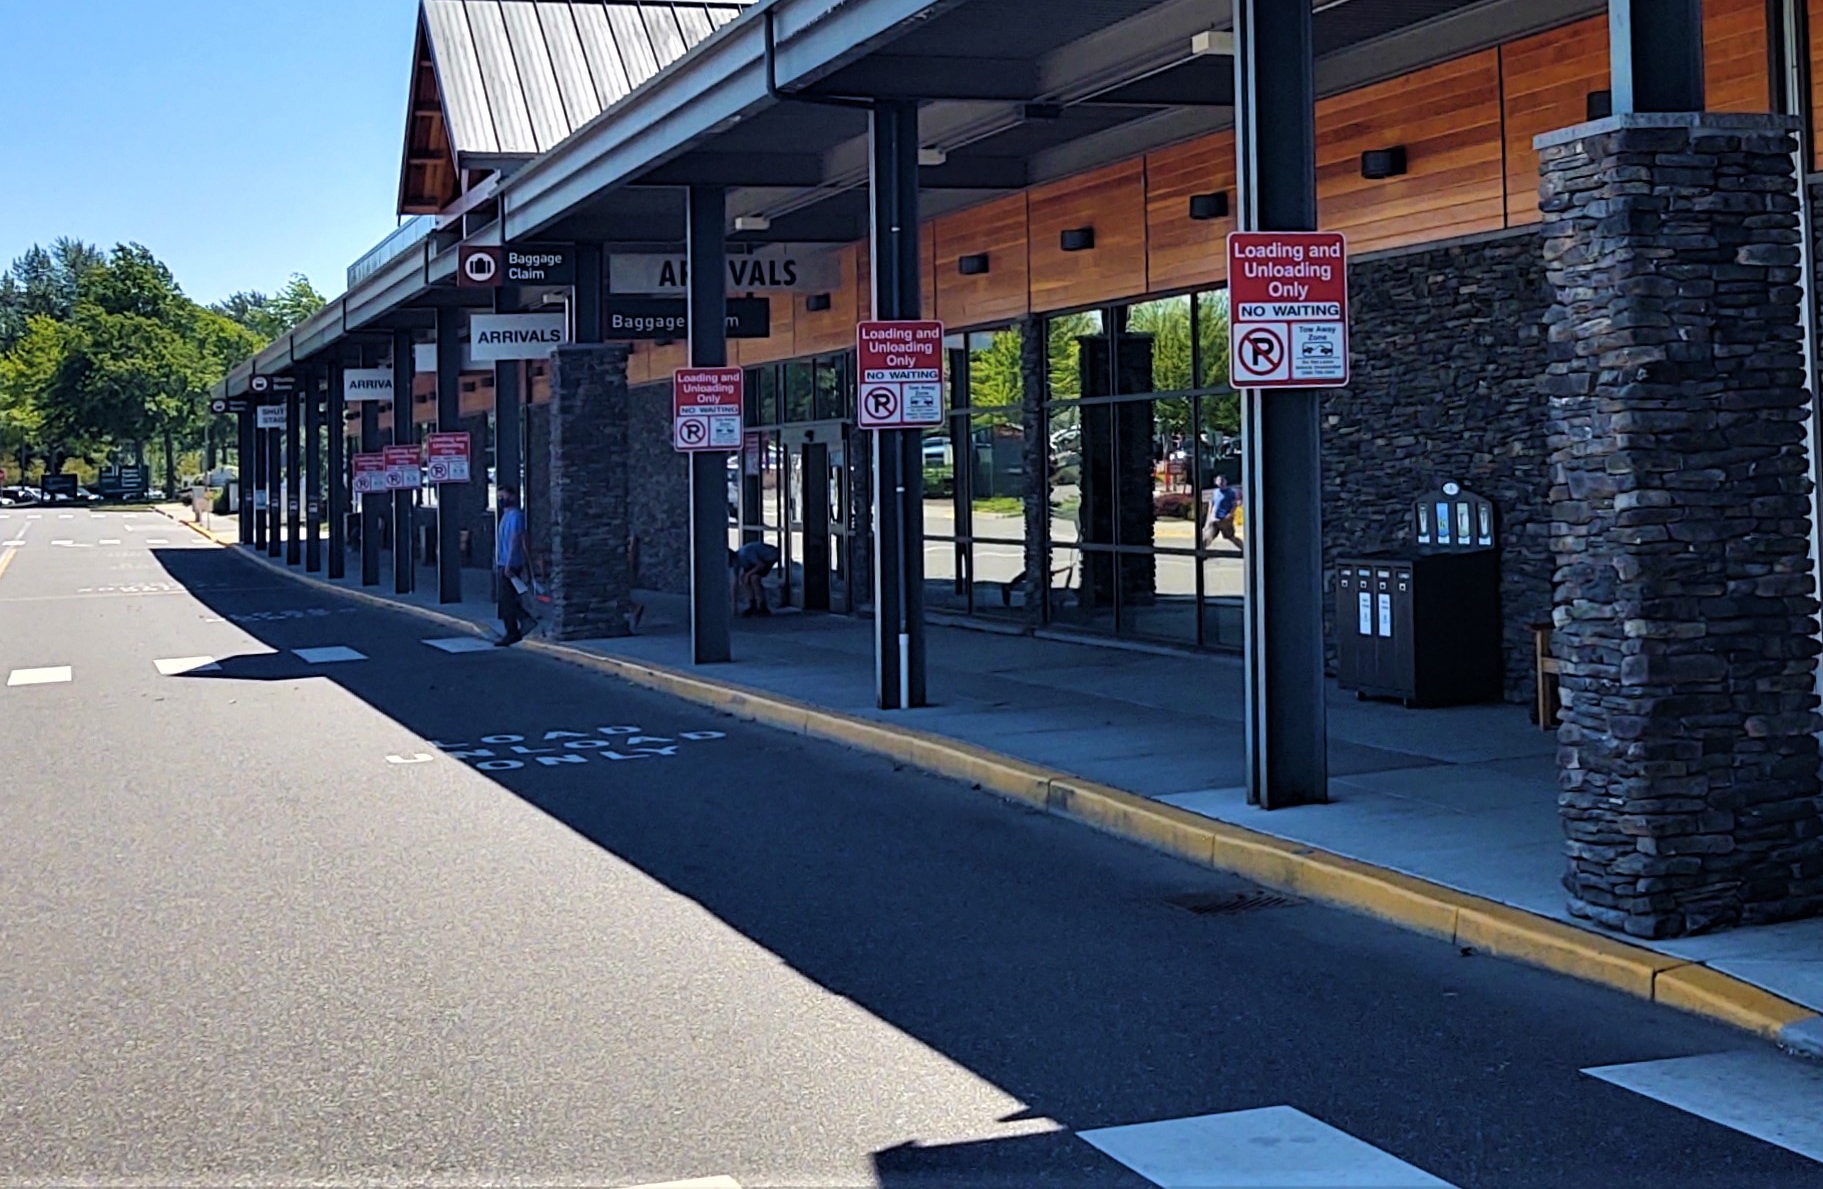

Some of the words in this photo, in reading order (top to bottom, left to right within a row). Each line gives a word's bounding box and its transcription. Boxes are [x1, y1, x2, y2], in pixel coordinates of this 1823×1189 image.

[1234, 242, 1304, 261] Loading
[1309, 242, 1341, 258] and
[508, 252, 562, 267] Baggage
[508, 267, 545, 280] Claim
[1244, 261, 1331, 281] Unloading
[1268, 281, 1309, 300] Only
[1241, 305, 1266, 317] NO
[1273, 304, 1339, 317] WAITING
[612, 314, 685, 330] Baggage
[477, 329, 561, 344] ARRIVALS
[862, 327, 913, 341] Loading
[916, 327, 940, 339] and
[1299, 326, 1314, 334] Tow
[1315, 326, 1336, 334] Away
[869, 341, 933, 354] Unloading
[886, 354, 916, 368] Only
[677, 373, 718, 383] Loading
[721, 372, 740, 382] and
[866, 371, 885, 380] NO
[889, 370, 938, 379] WAITING
[349, 379, 393, 390] ARRIVA
[683, 384, 734, 394] Unloading
[697, 394, 721, 404] Only
[428, 725, 642, 750] LOAD
[385, 730, 727, 764] UNLOAD
[476, 744, 681, 771] ONLY
